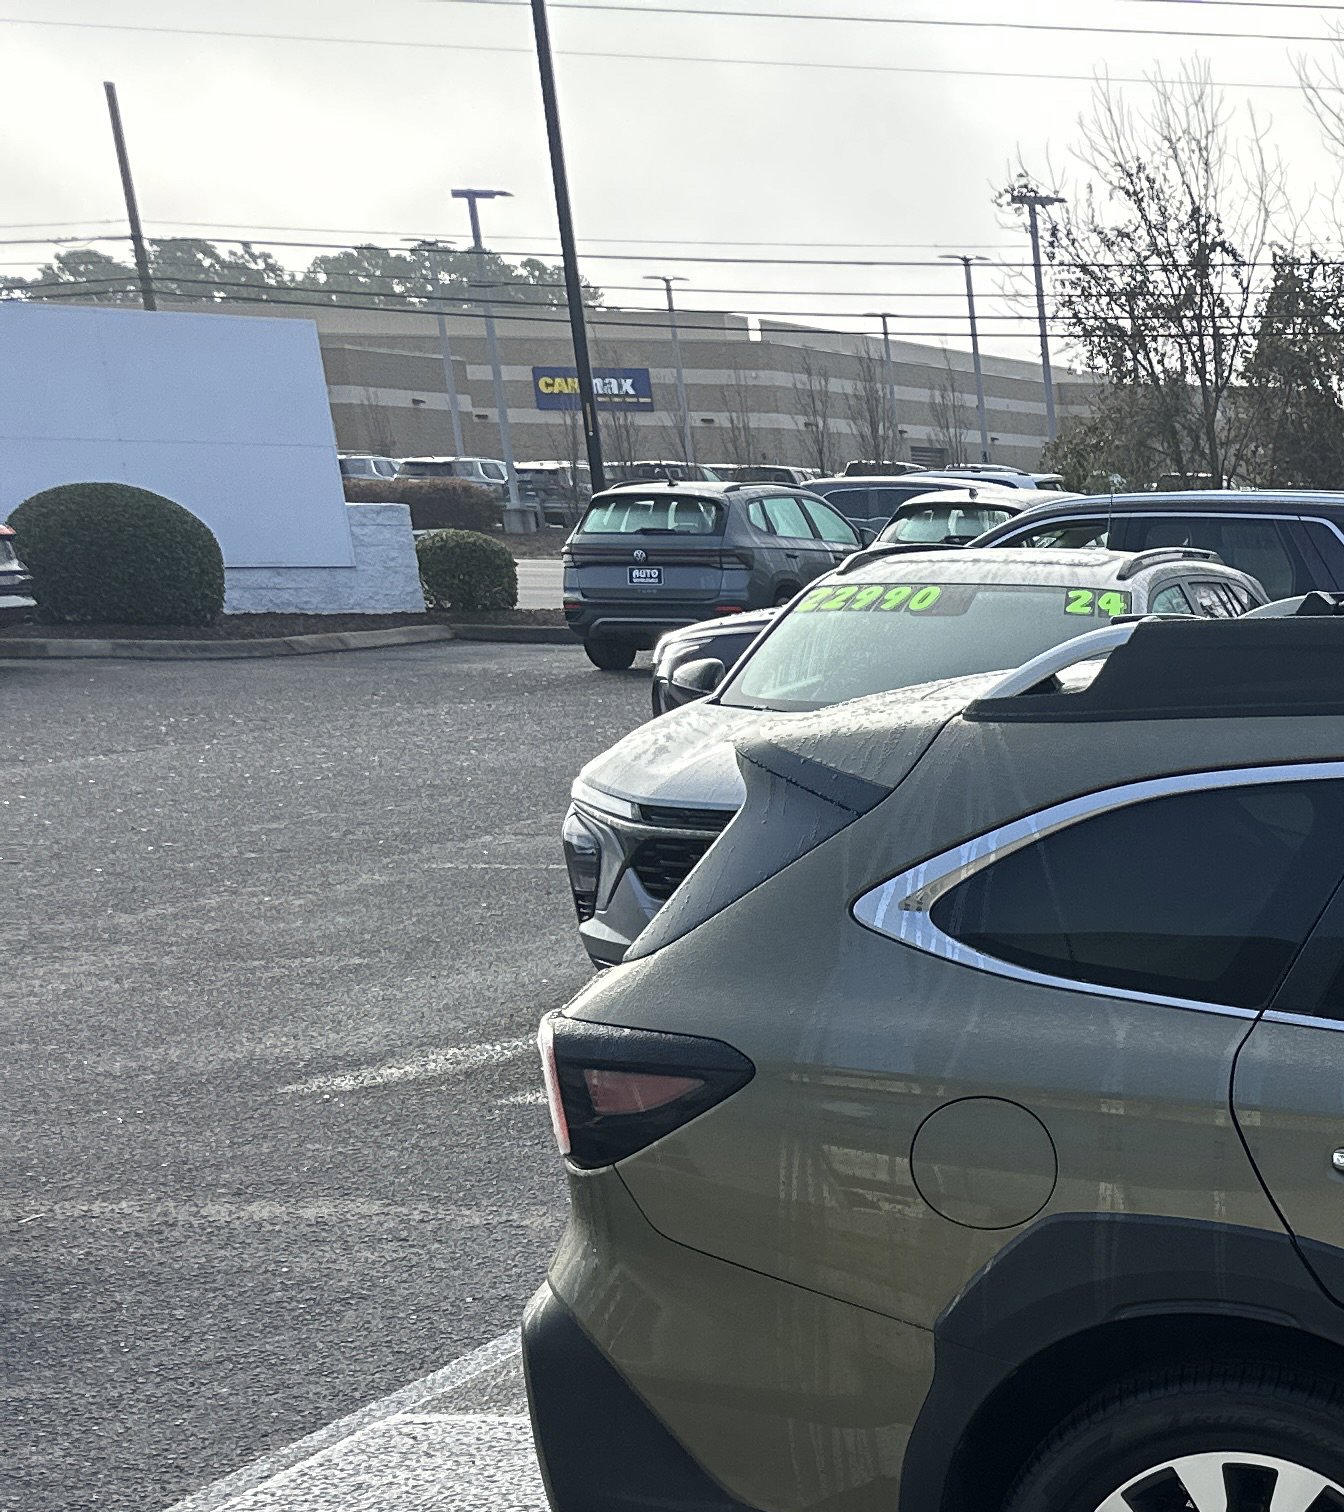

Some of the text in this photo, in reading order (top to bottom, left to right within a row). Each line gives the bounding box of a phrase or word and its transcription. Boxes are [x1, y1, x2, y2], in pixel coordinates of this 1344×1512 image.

[632, 569, 659, 578] AUTO
[794, 585, 1128, 617] 22990 24
